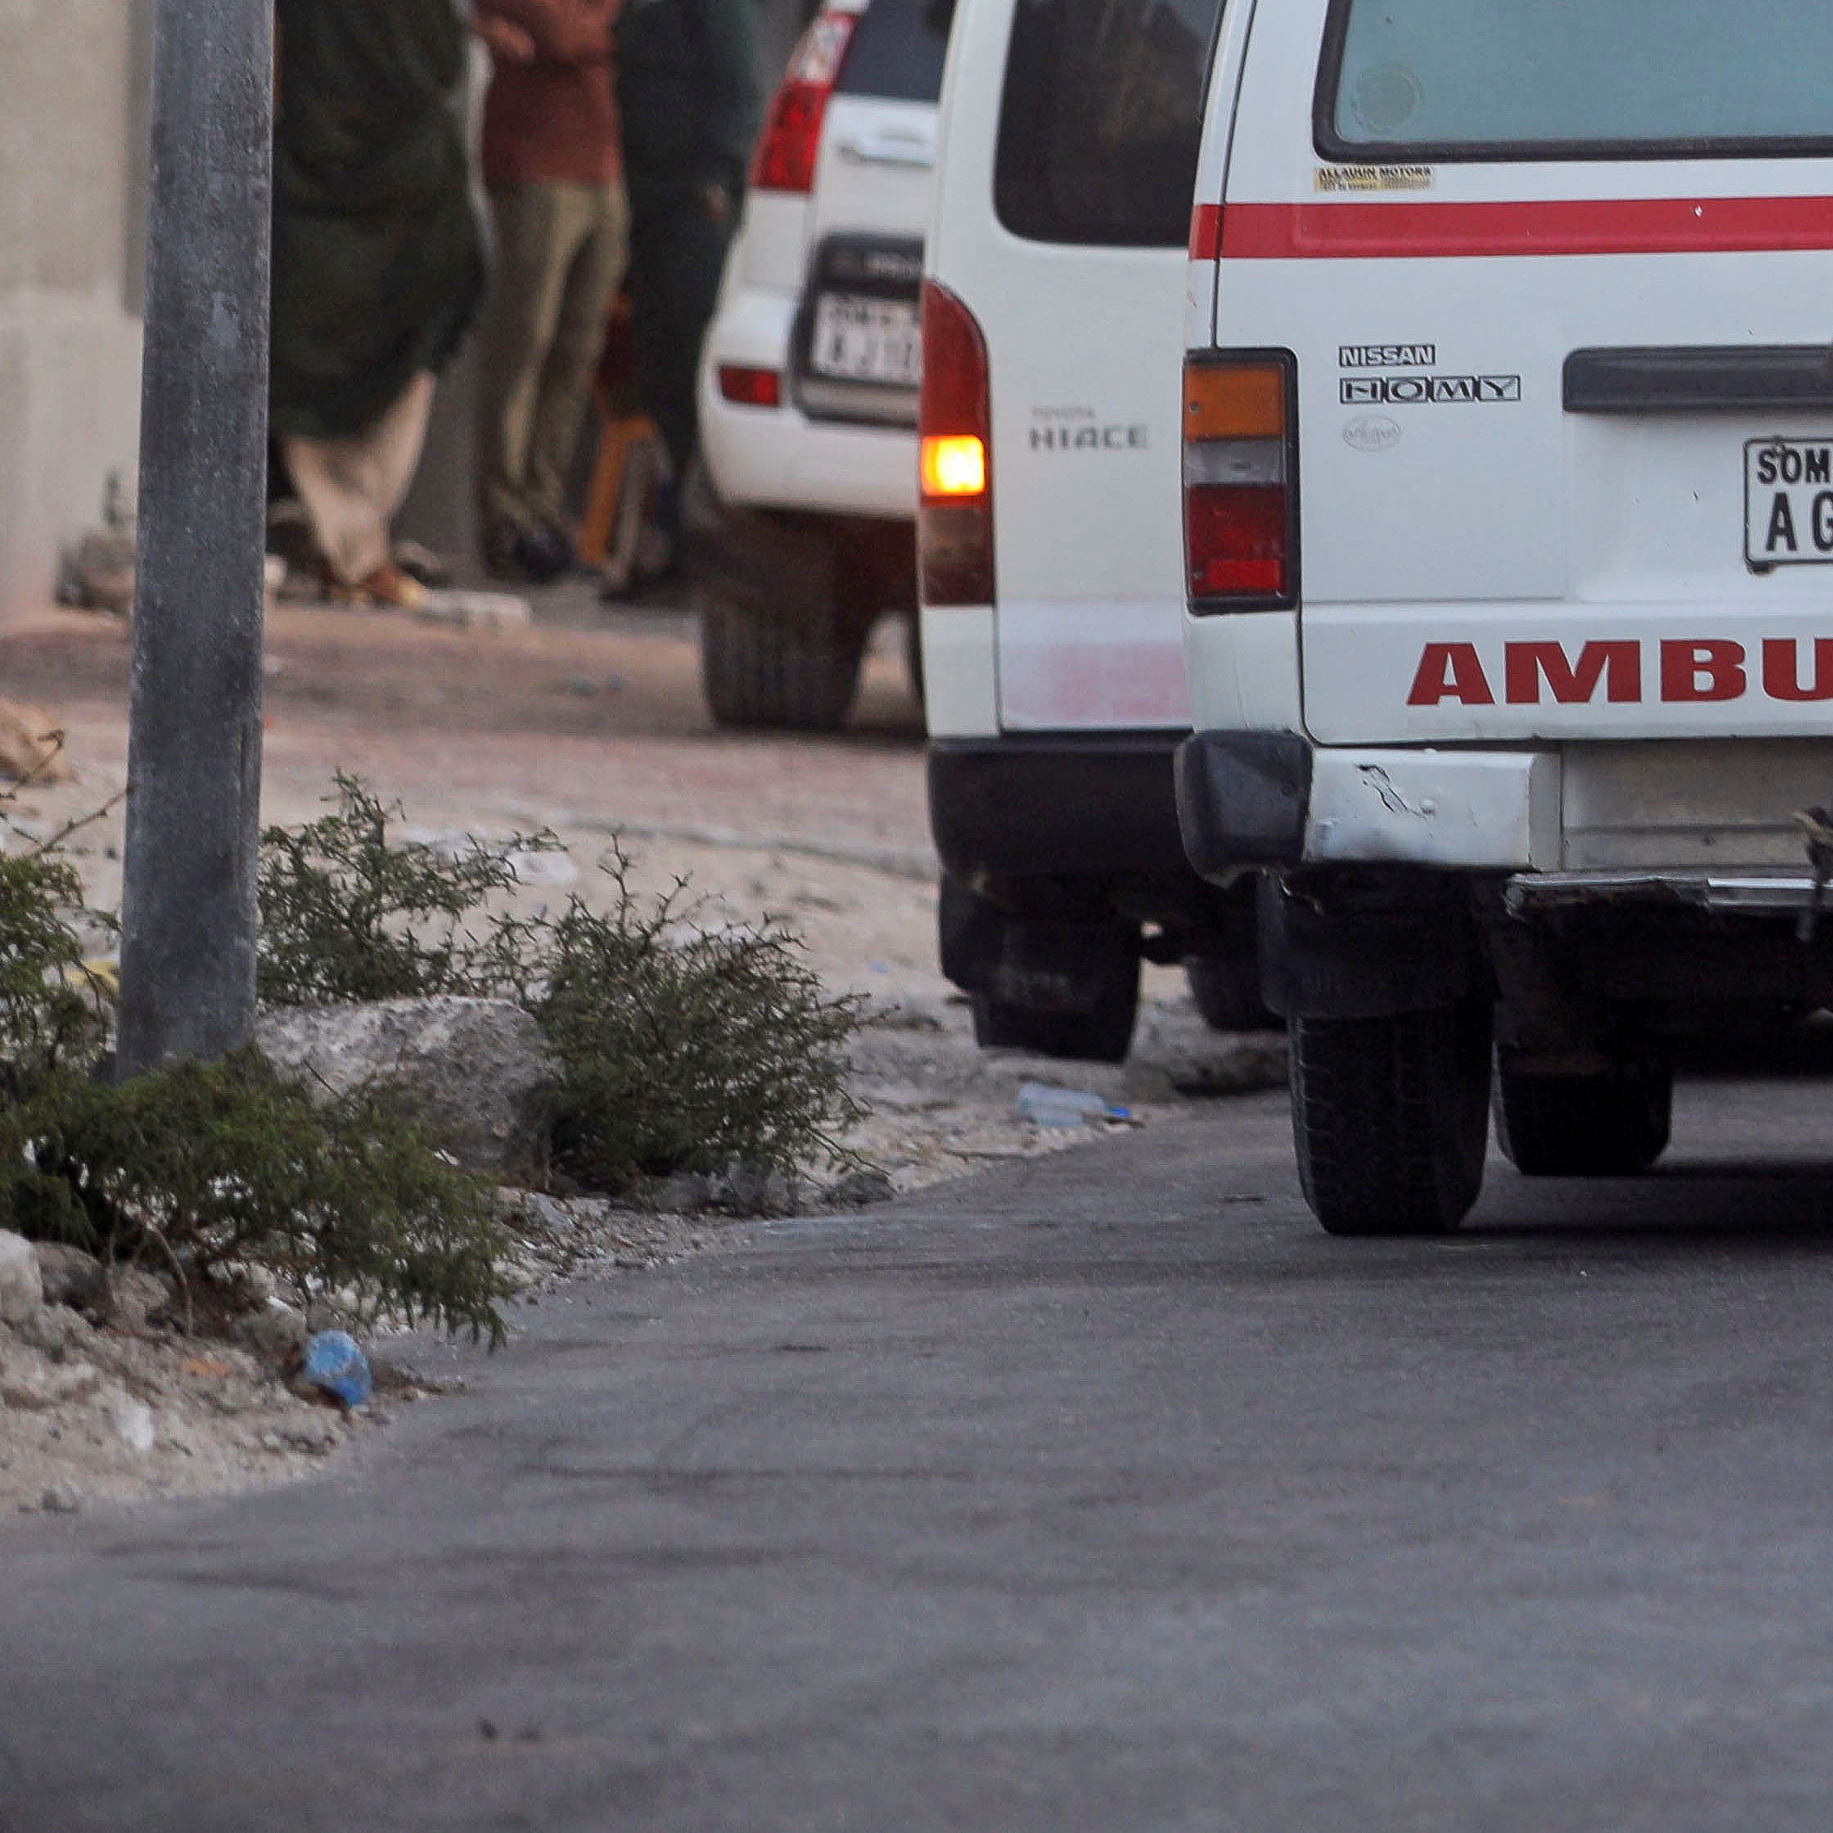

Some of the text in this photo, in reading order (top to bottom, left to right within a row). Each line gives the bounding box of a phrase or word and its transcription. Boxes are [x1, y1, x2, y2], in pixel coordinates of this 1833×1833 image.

[1340, 345, 1435, 366] NISSAN
[1342, 377, 1518, 403] HOMY
[1029, 425, 1150, 451] HIACE
[1757, 447, 1831, 485] SOM
